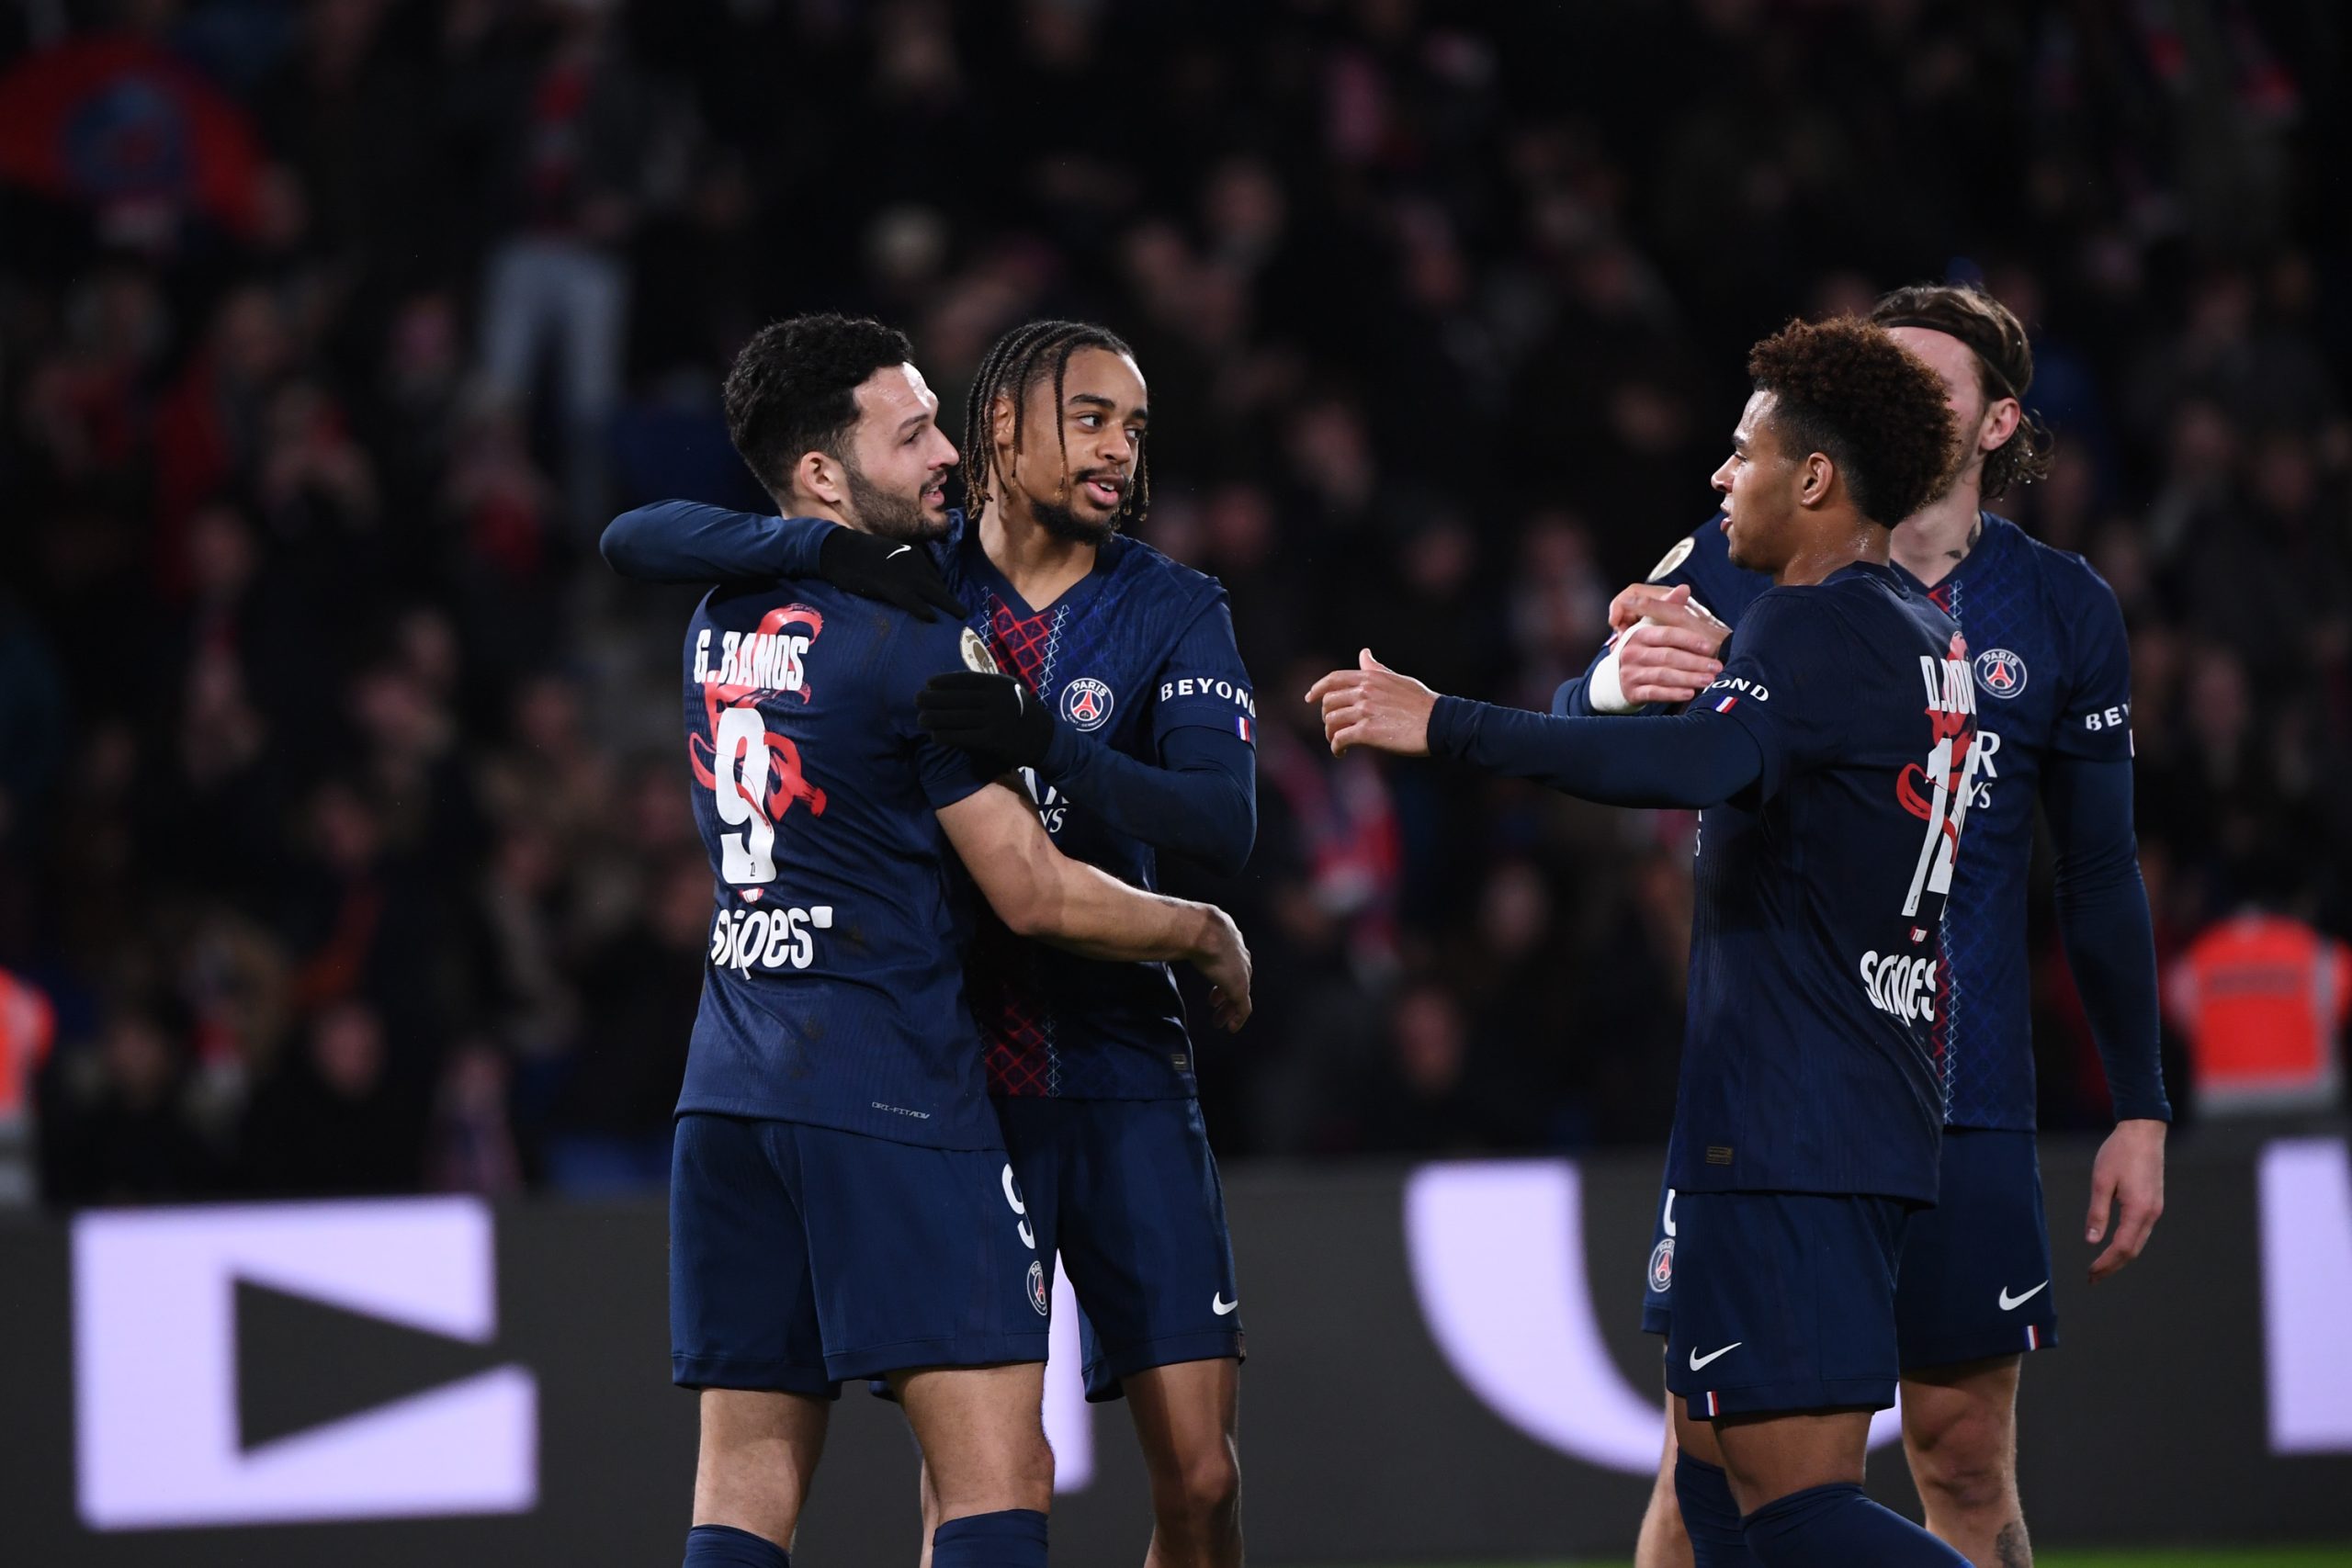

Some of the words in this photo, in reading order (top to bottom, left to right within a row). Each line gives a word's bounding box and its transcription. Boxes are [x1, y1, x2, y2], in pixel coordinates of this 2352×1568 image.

[1983, 651, 2018, 667] PARIS
[1072, 681, 1107, 697] PARIS
[715, 707, 777, 884] 9
